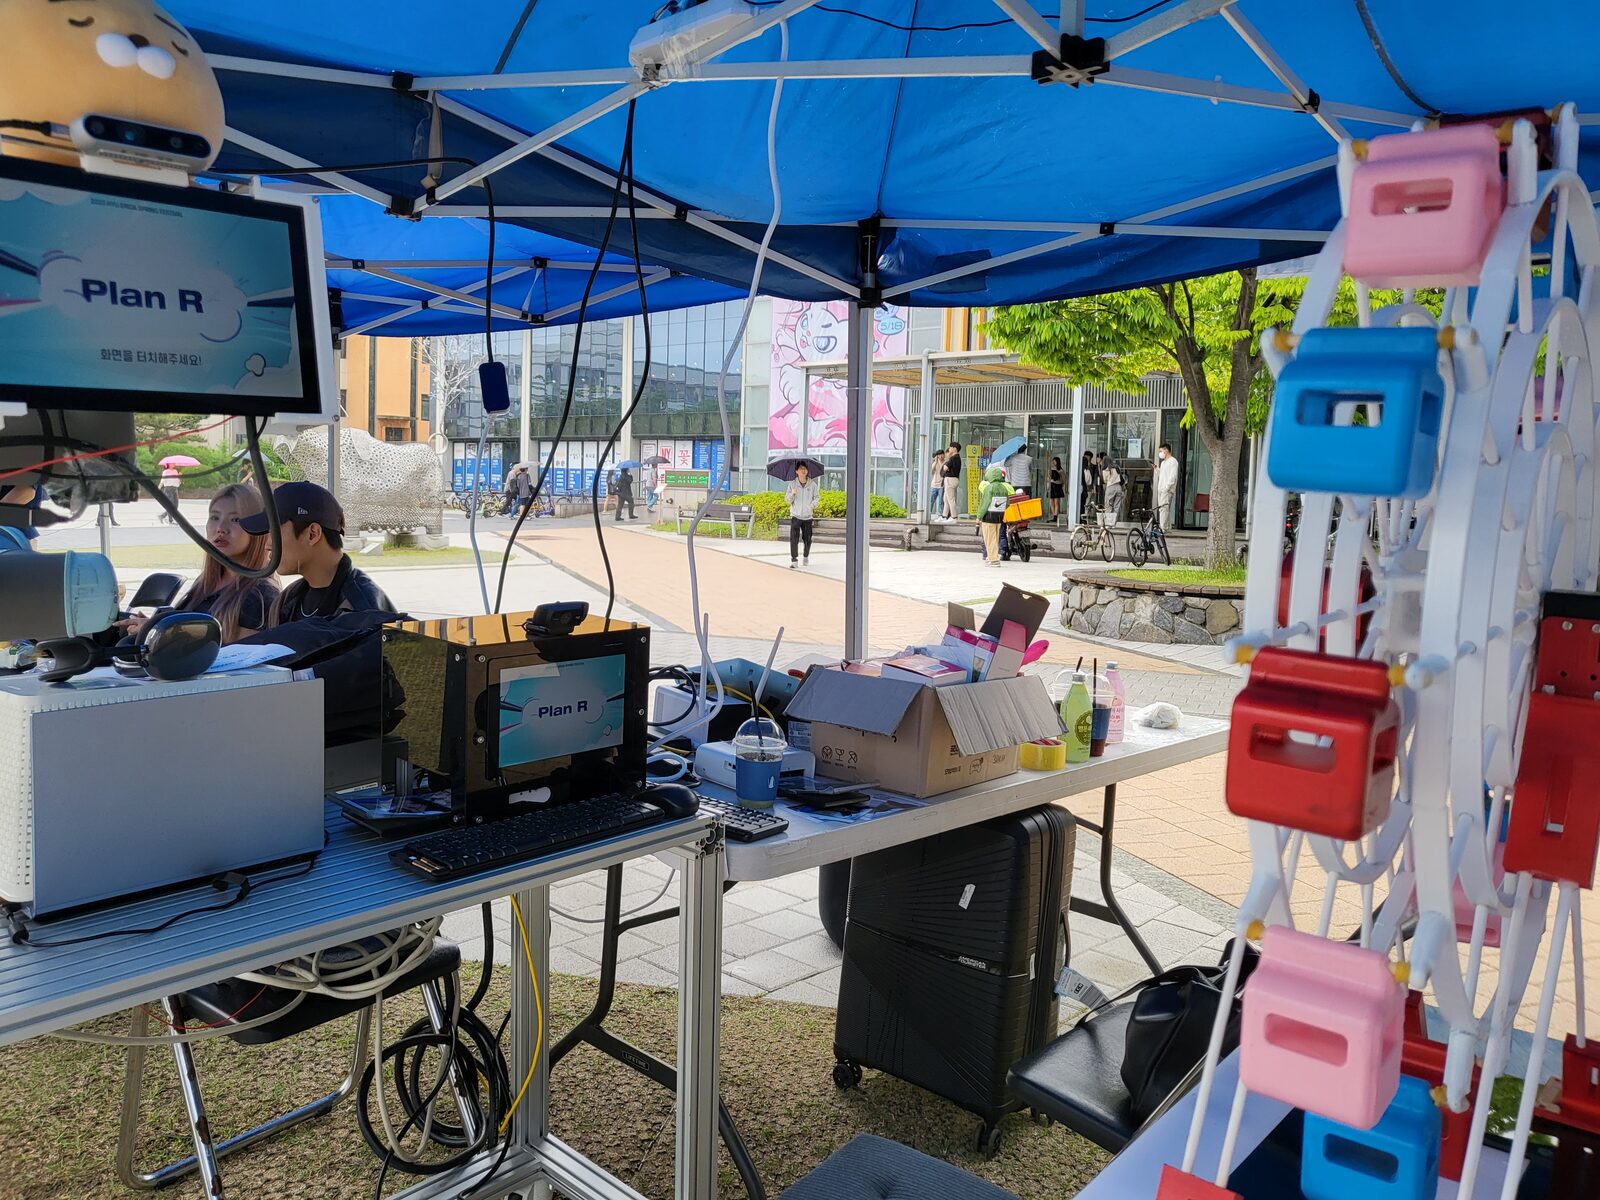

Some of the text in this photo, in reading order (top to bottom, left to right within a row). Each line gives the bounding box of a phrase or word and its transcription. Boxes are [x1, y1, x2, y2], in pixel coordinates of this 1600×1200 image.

[81, 278, 204, 314] Plan R
[880, 321, 903, 331] 5/18
[100, 348, 202, 366] 화면을 터치해주세요!
[538, 700, 588, 719] Plan R
